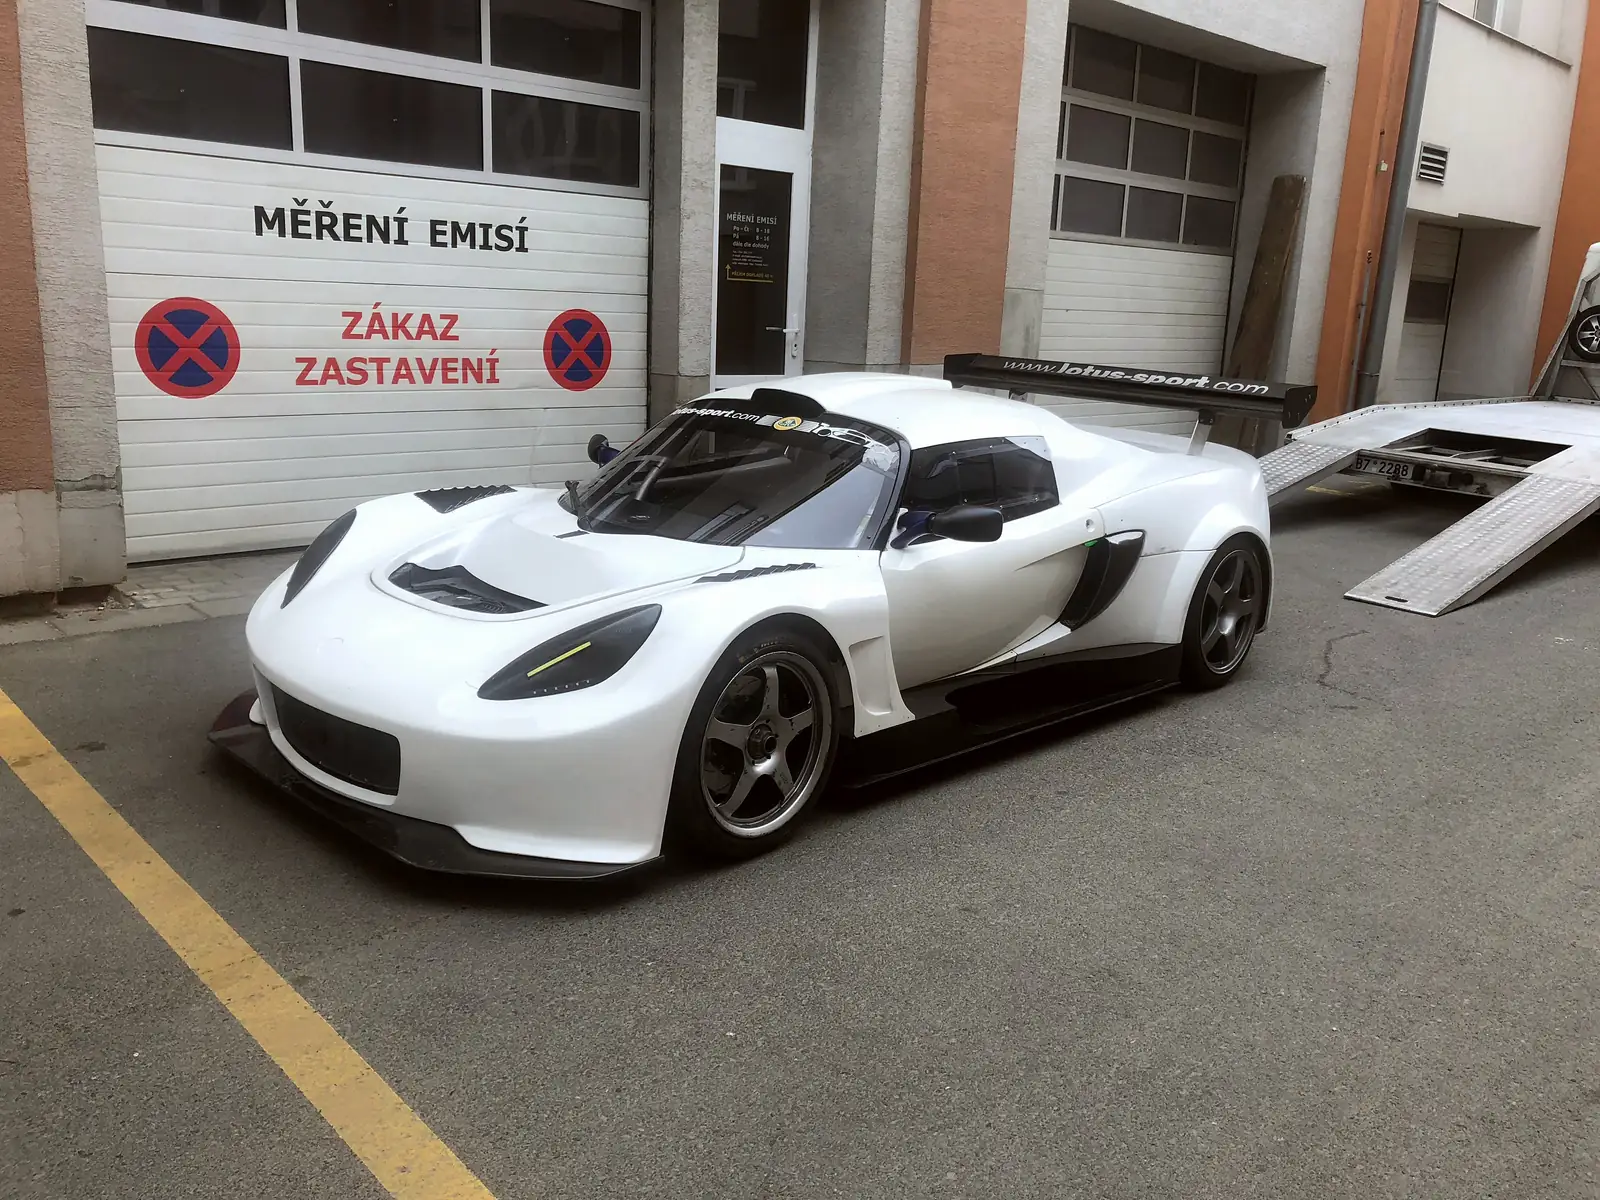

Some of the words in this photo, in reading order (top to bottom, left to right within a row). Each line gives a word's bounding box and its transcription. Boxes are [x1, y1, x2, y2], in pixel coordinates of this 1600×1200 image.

[254, 198, 409, 246] MĚŘENÍ
[429, 217, 529, 253] EMISÍ
[726, 212, 754, 222] MĚŘENÍ
[756, 215, 777, 225] EMISÍ
[752, 242, 770, 250] dohody
[341, 302, 460, 341] ZÁKAZ
[295, 349, 500, 386] ZASTAVENÍ
[1003, 361, 1269, 395] www.lotus-sport.com
[1378, 461, 1409, 477] 2288
